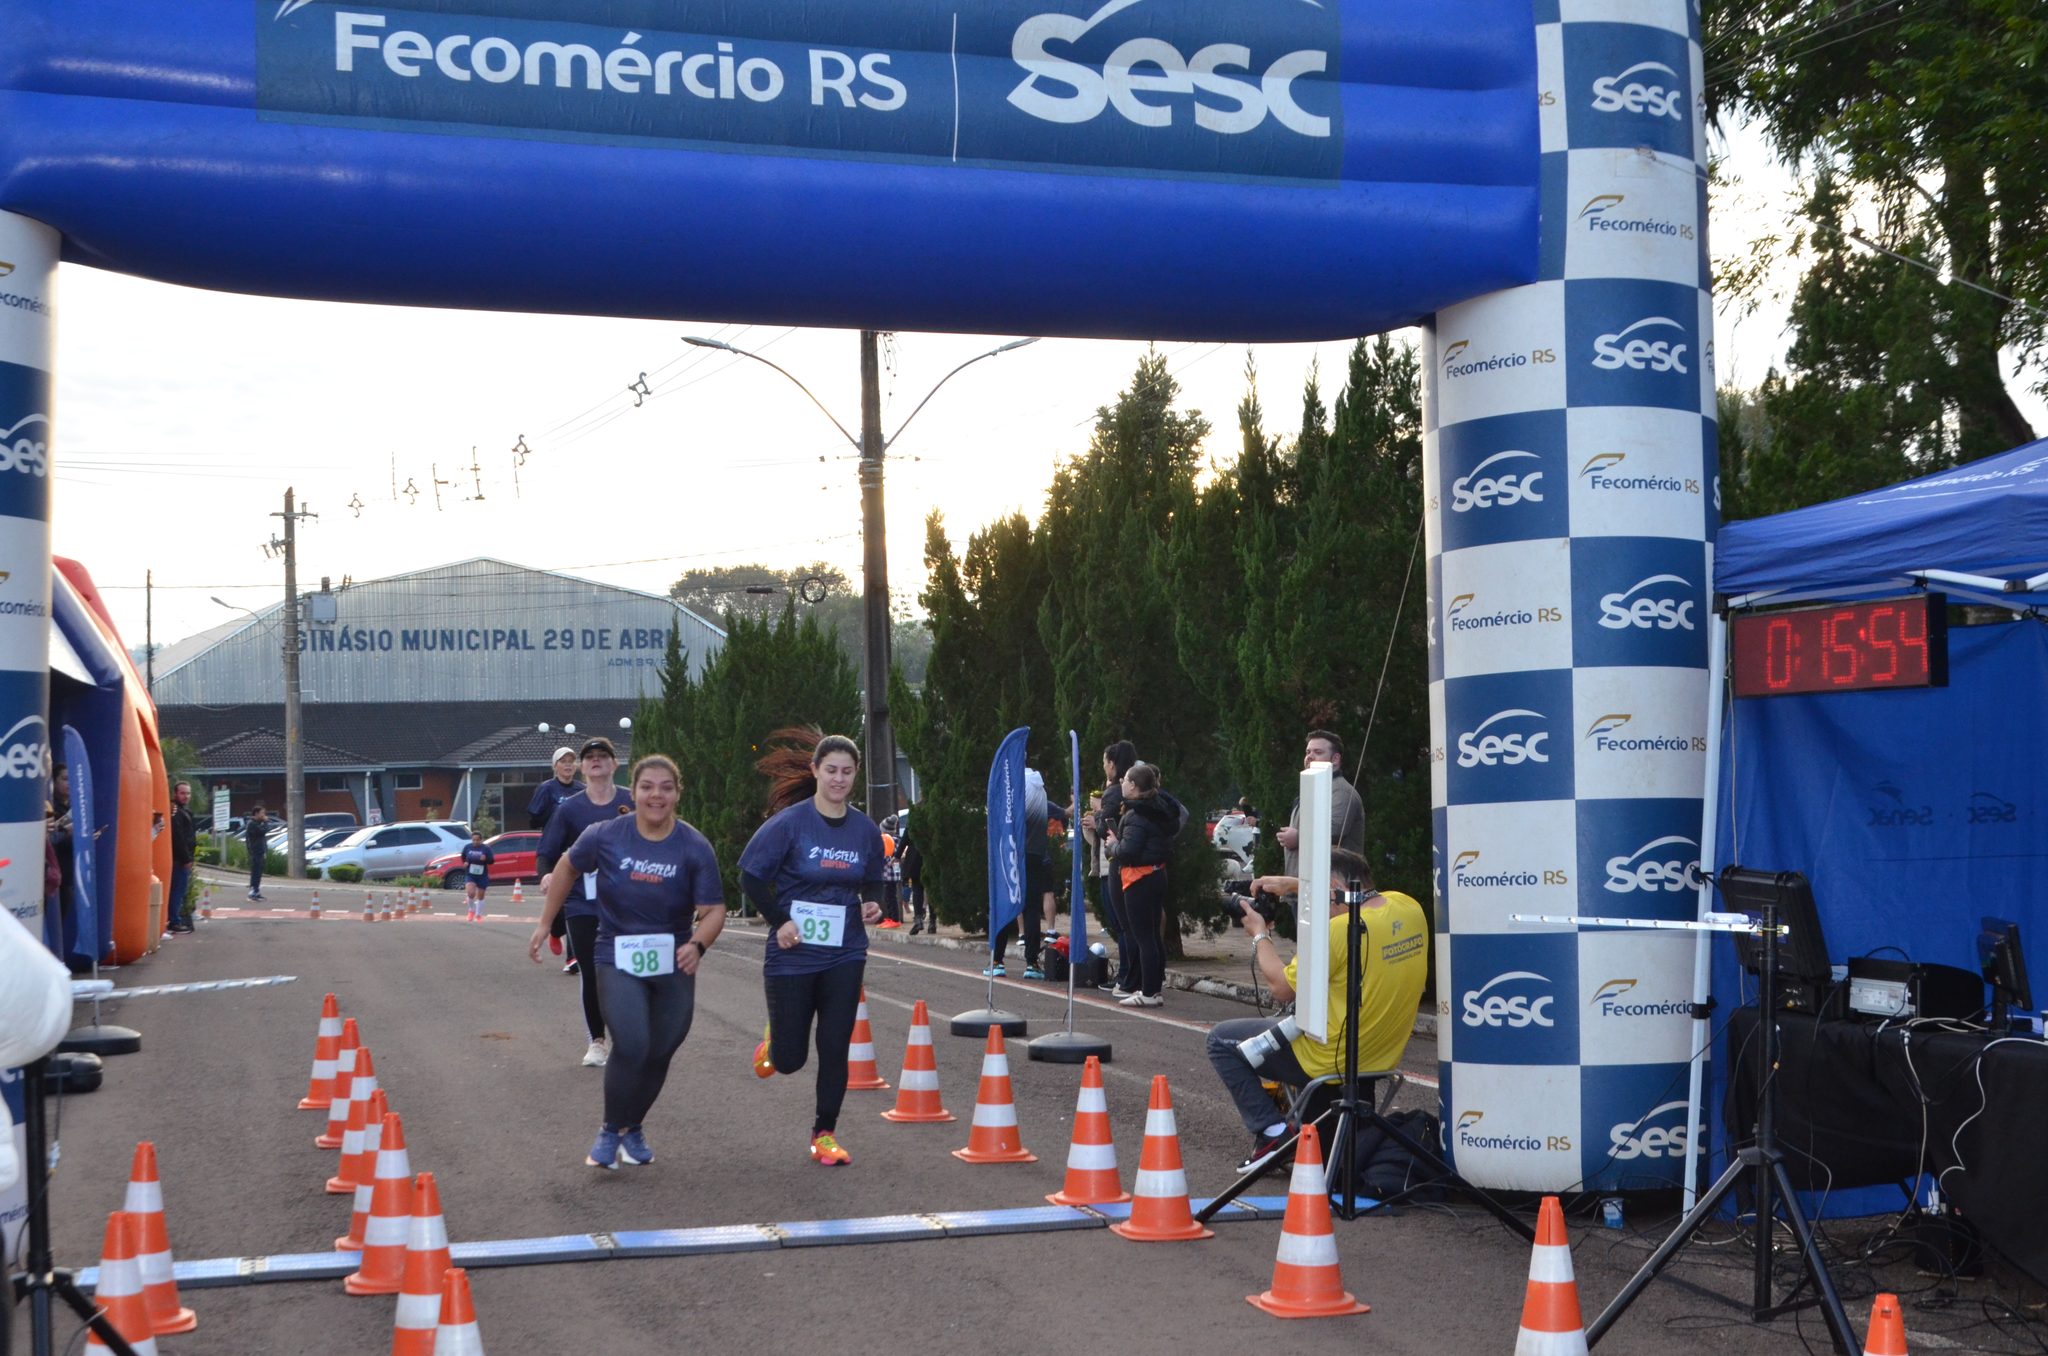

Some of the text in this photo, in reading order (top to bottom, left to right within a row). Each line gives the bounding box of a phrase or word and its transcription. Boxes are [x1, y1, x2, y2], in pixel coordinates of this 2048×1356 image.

[335, 12, 907, 111] Fecomércio RS
[1006, 13, 1331, 137] Sesc
[1592, 76, 1682, 121] Sesc
[1589, 216, 1694, 241] Fecomércio RS
[1446, 349, 1556, 379] Fecomércio RS
[1592, 333, 1688, 374] Sesc
[1452, 471, 1543, 513] Sesc
[1591, 475, 1681, 492] Fecomércio
[1685, 478, 1699, 494] RS
[1452, 608, 1562, 631] Fecomércio RS
[1598, 593, 1694, 630] Sesc
[298, 624, 686, 652] GINÁSIO MUNICIPAL 29 DE ABR
[1766, 607, 1928, 688] 0:15:54
[1457, 731, 1548, 767] Sesc
[1597, 736, 1706, 751] Fecomércio RS
[1457, 871, 1537, 887] Fecomércio
[1544, 870, 1567, 885] RS
[1604, 856, 1699, 893] Sesc
[803, 918, 830, 941] 93
[631, 949, 659, 973] 98
[1462, 990, 1553, 1027] Sesc
[1461, 1133, 1541, 1150] Fecomércio
[1547, 1136, 1571, 1151] RS
